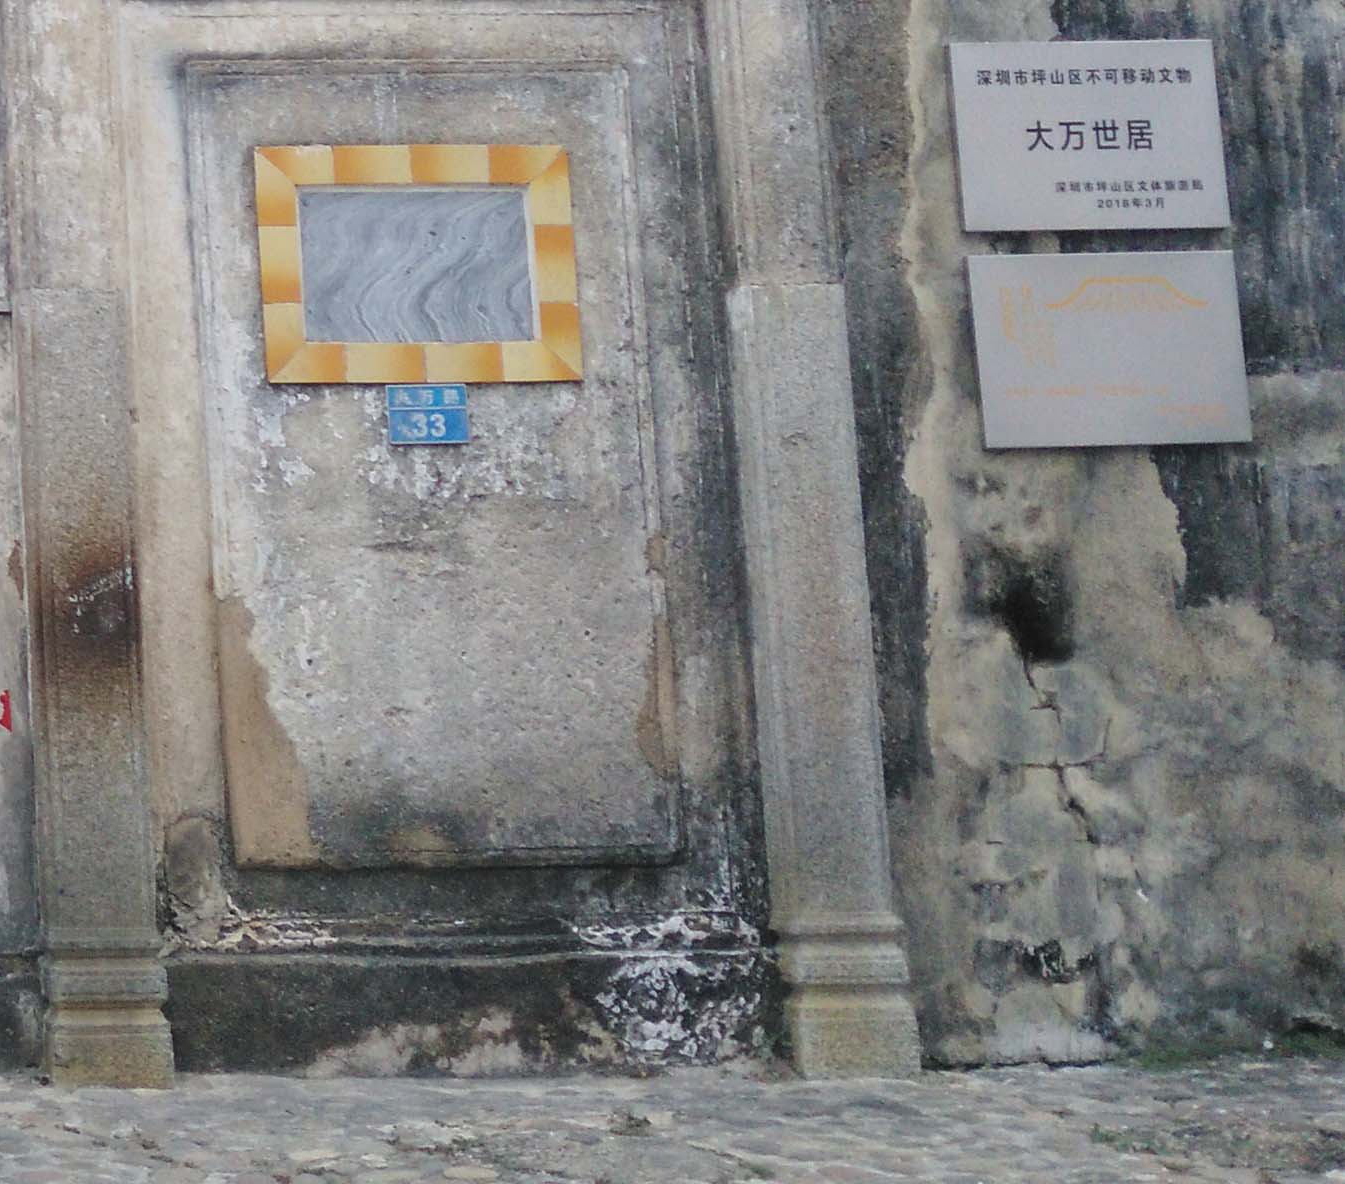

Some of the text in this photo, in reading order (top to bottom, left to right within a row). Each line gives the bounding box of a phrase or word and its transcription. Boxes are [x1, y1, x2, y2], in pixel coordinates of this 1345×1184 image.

[976, 68, 1193, 87] 深圳市坪山区不可移动文物
[1025, 119, 1154, 152] 大万世居
[411, 413, 447, 438] 33
